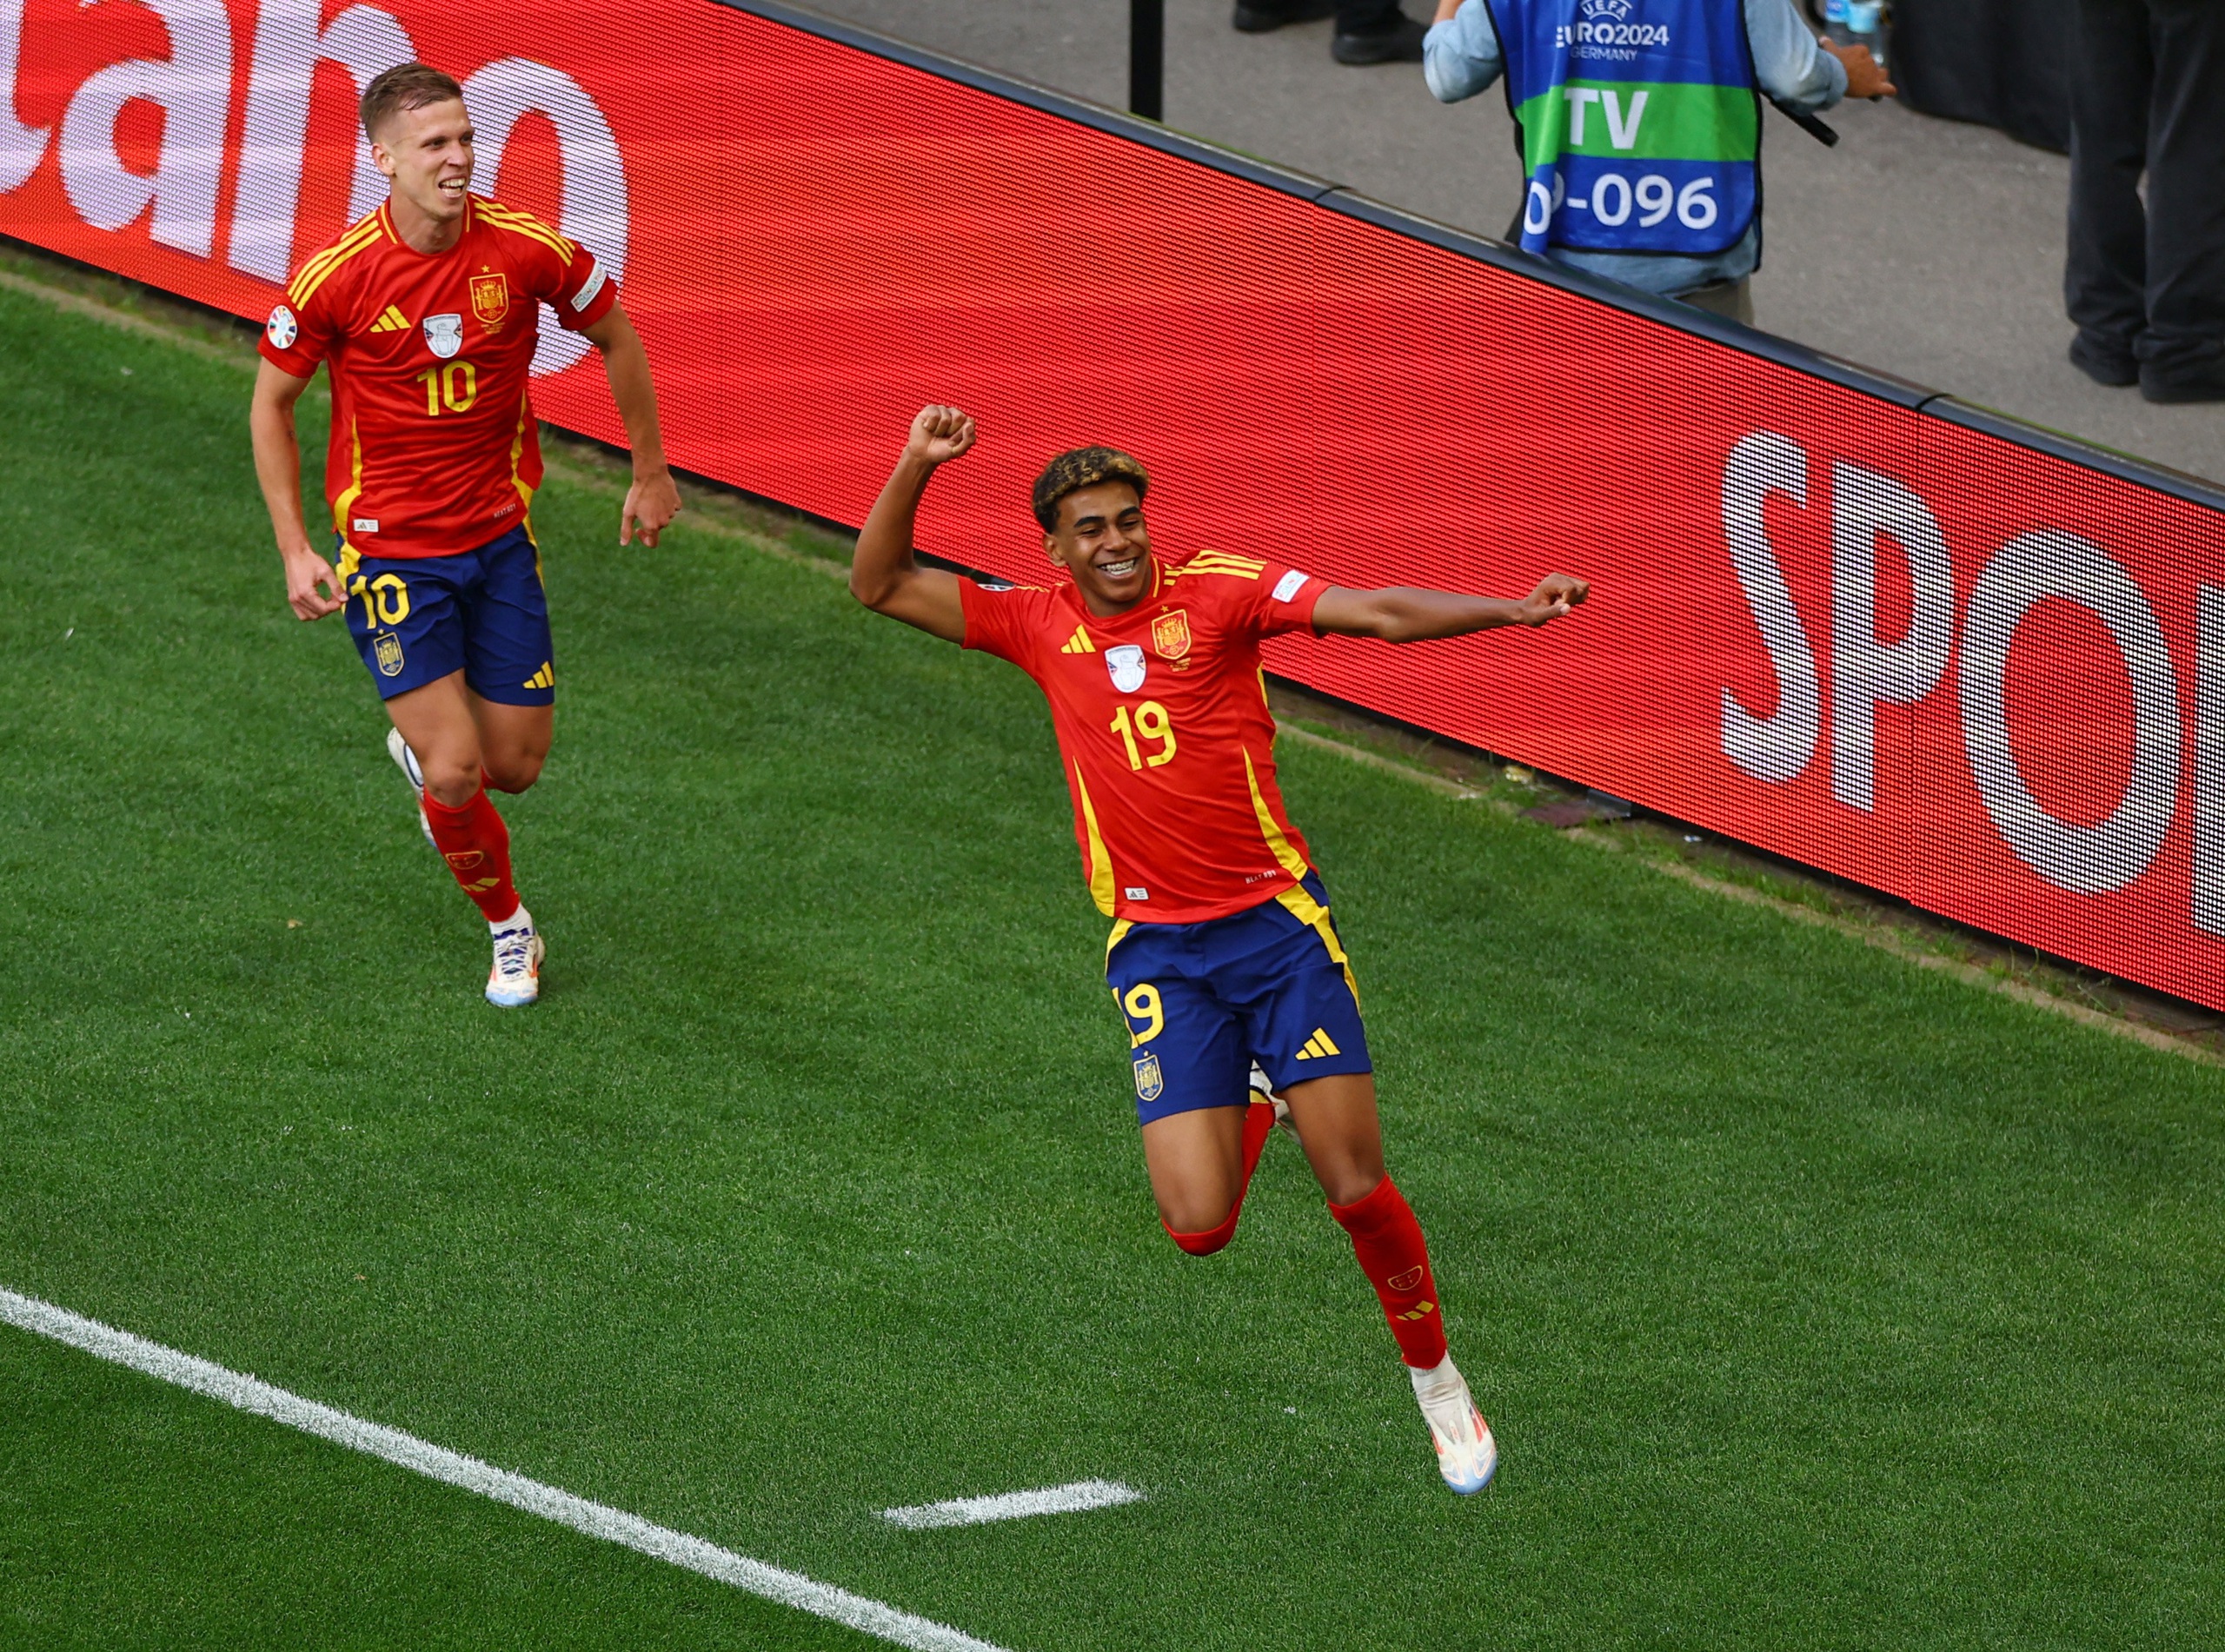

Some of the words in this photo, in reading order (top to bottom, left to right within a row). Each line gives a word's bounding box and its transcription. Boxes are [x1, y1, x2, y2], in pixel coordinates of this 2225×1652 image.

[1582, 0, 1628, 17] UEFA
[1570, 45, 1637, 61] GERMANY
[1564, 87, 1650, 150] TV
[417, 360, 477, 416] 10
[350, 574, 410, 629] 10
[1110, 700, 1177, 771] 19
